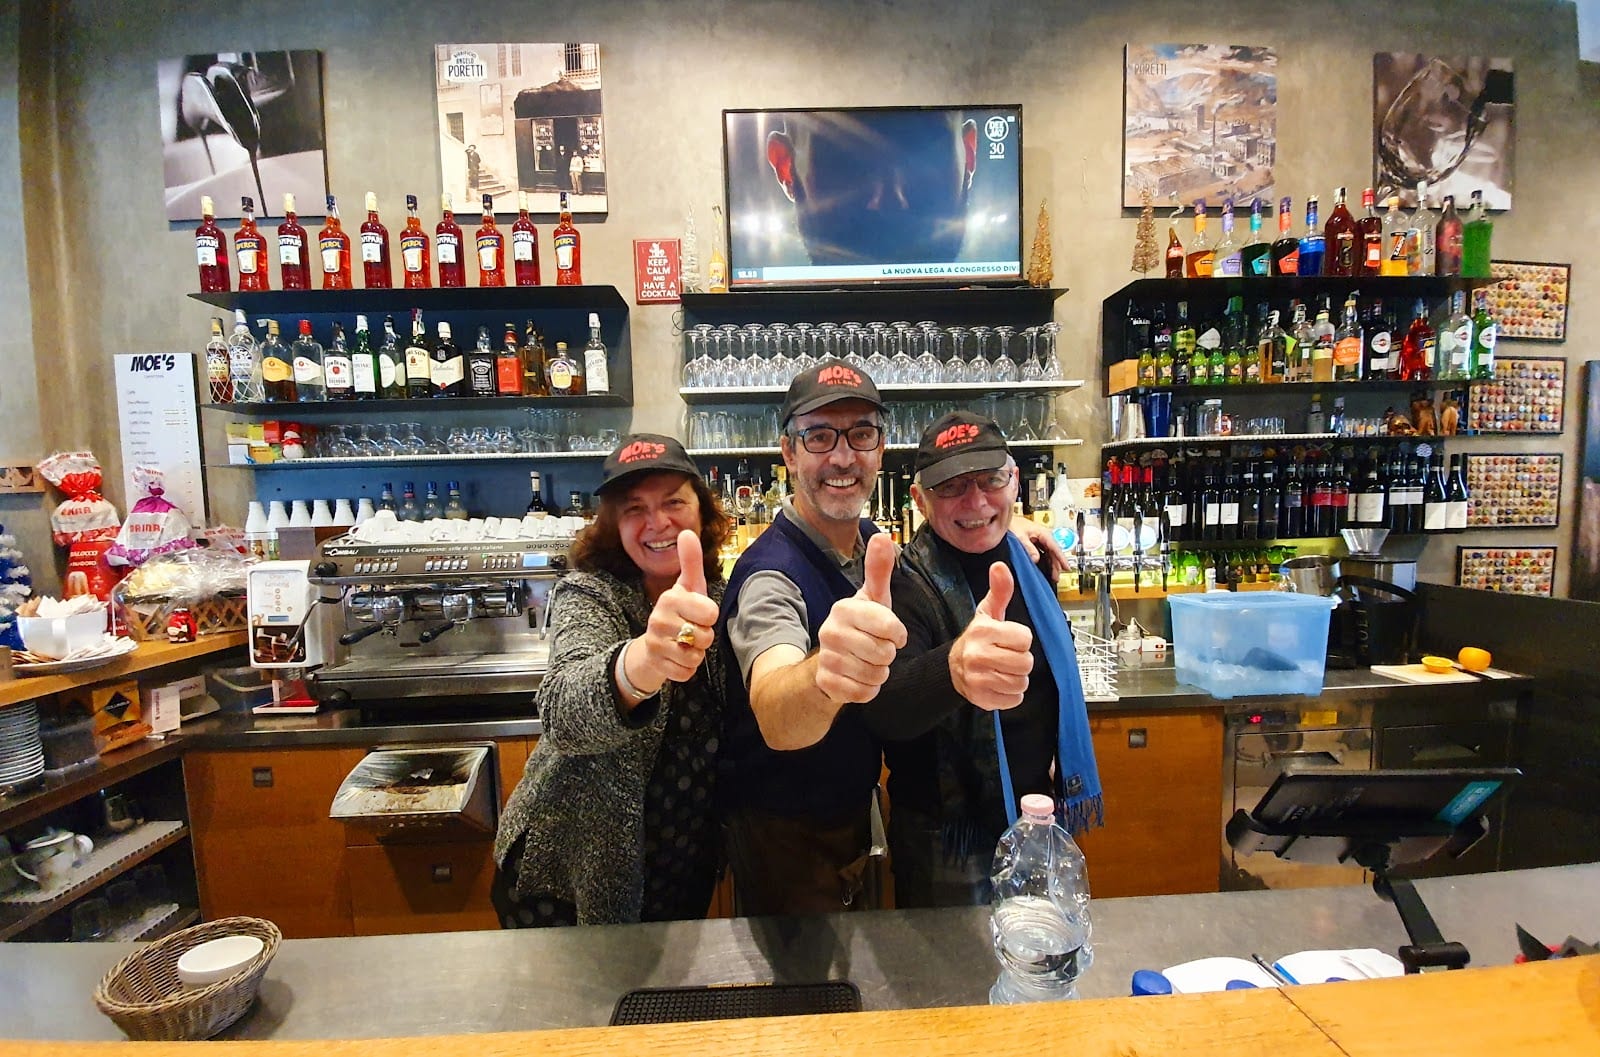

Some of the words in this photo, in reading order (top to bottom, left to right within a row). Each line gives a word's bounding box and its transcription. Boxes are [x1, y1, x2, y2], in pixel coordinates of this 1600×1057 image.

[448, 64, 483, 77] PORETTI
[989, 142, 1005, 155] 30
[647, 258, 668, 266] KEEP
[646, 266, 671, 275] CALM
[894, 267, 923, 275] NUOVA
[924, 266, 945, 274] LEGA
[954, 265, 1002, 273] CONGRESSO
[643, 281, 666, 289] HAVE
[669, 281, 676, 289] A
[130, 354, 175, 372] MOE'S
[818, 365, 862, 384] MOE'S
[827, 379, 858, 388] MILANO
[935, 423, 979, 449] MOE'S
[942, 437, 973, 449] MILANO
[618, 441, 667, 463] MOE'S
[625, 453, 658, 464] MILANO
